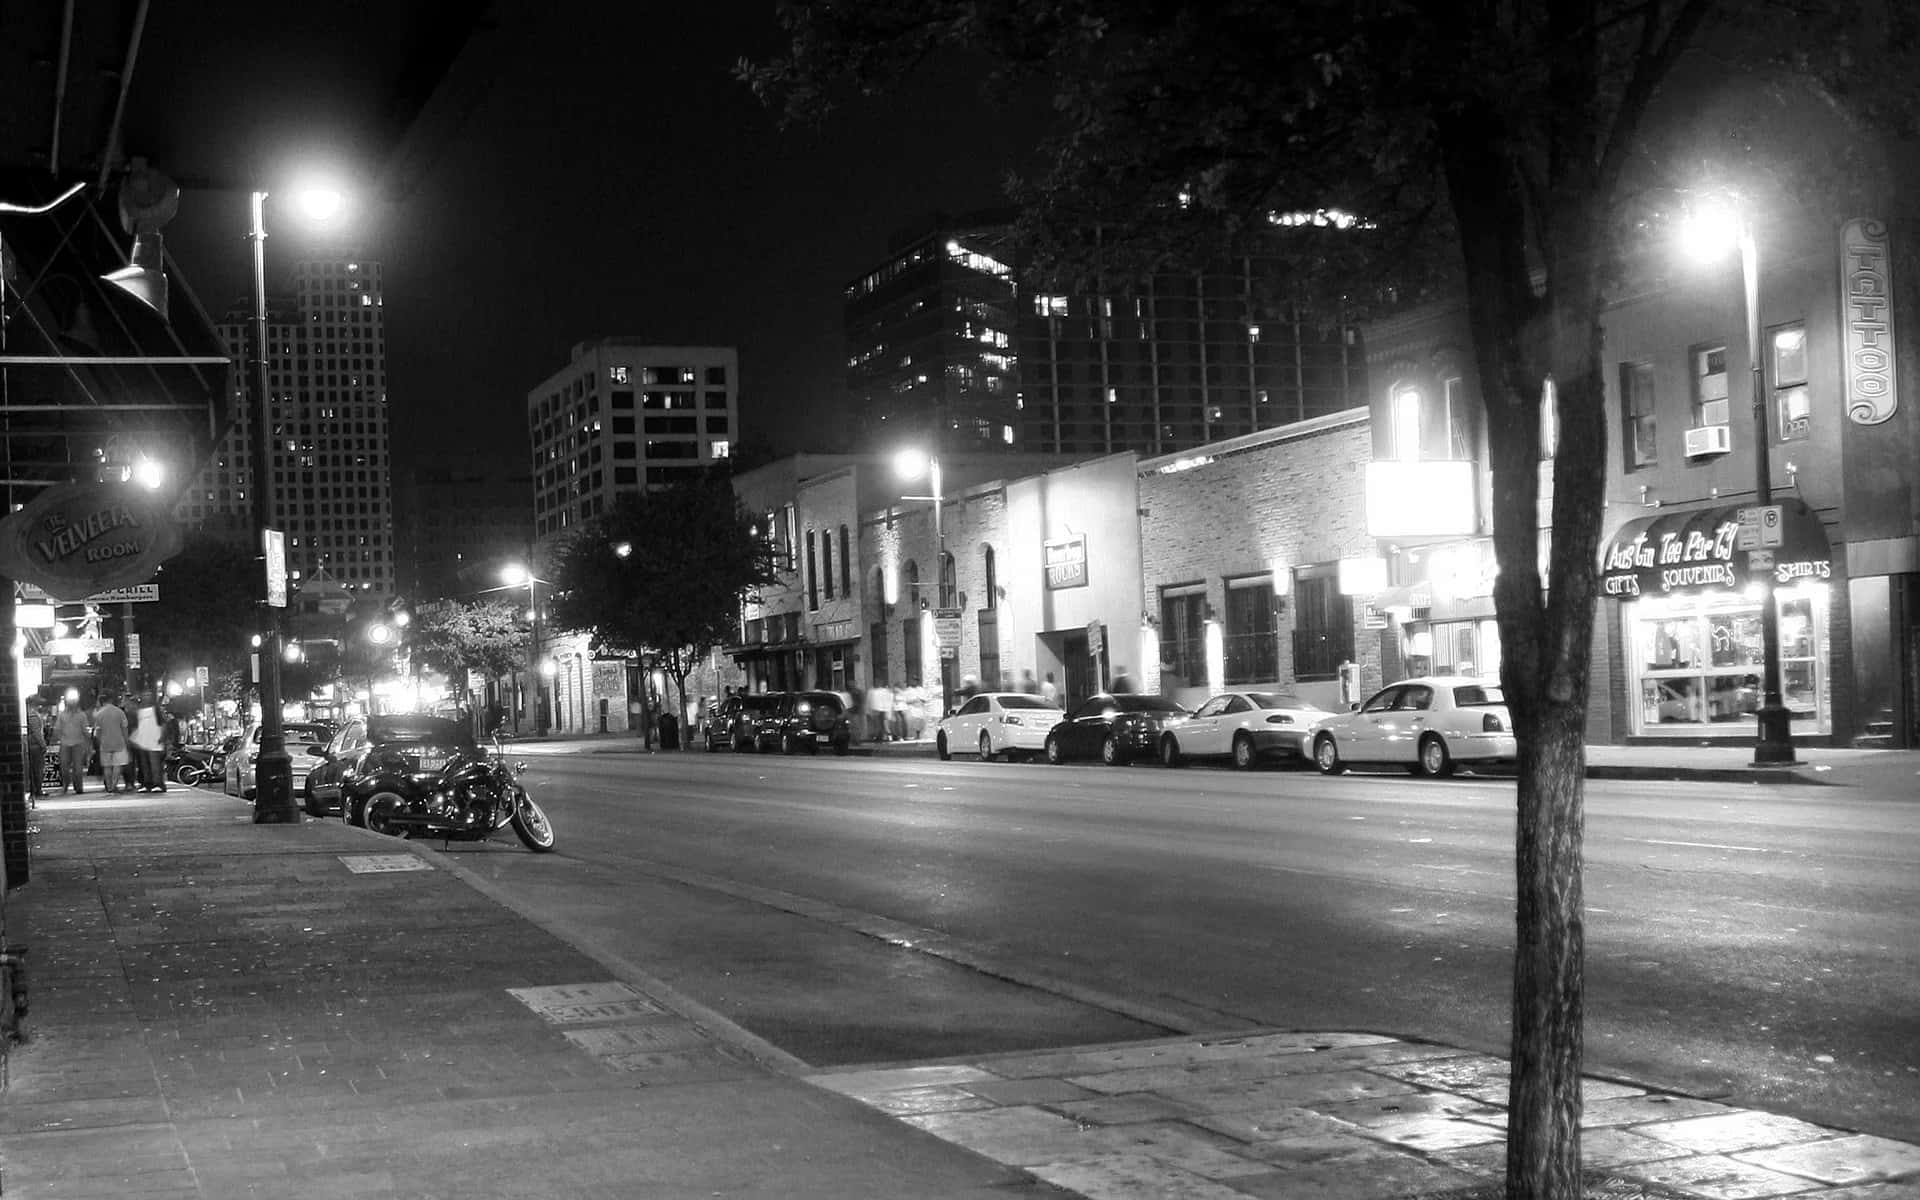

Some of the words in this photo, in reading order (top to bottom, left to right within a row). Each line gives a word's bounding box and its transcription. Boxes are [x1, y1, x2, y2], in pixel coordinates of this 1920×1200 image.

[1848, 245, 1889, 398] TATTOO
[39, 504, 140, 561] VELVEETA
[87, 540, 139, 561] ROOM
[1606, 531, 1655, 570] Austin
[1659, 531, 1683, 565] Tee
[1684, 521, 1739, 562] Party
[1605, 574, 1640, 596] GIFTS
[1662, 562, 1735, 592] SOUVENIRS
[1773, 560, 1831, 583] -SHIRTS
